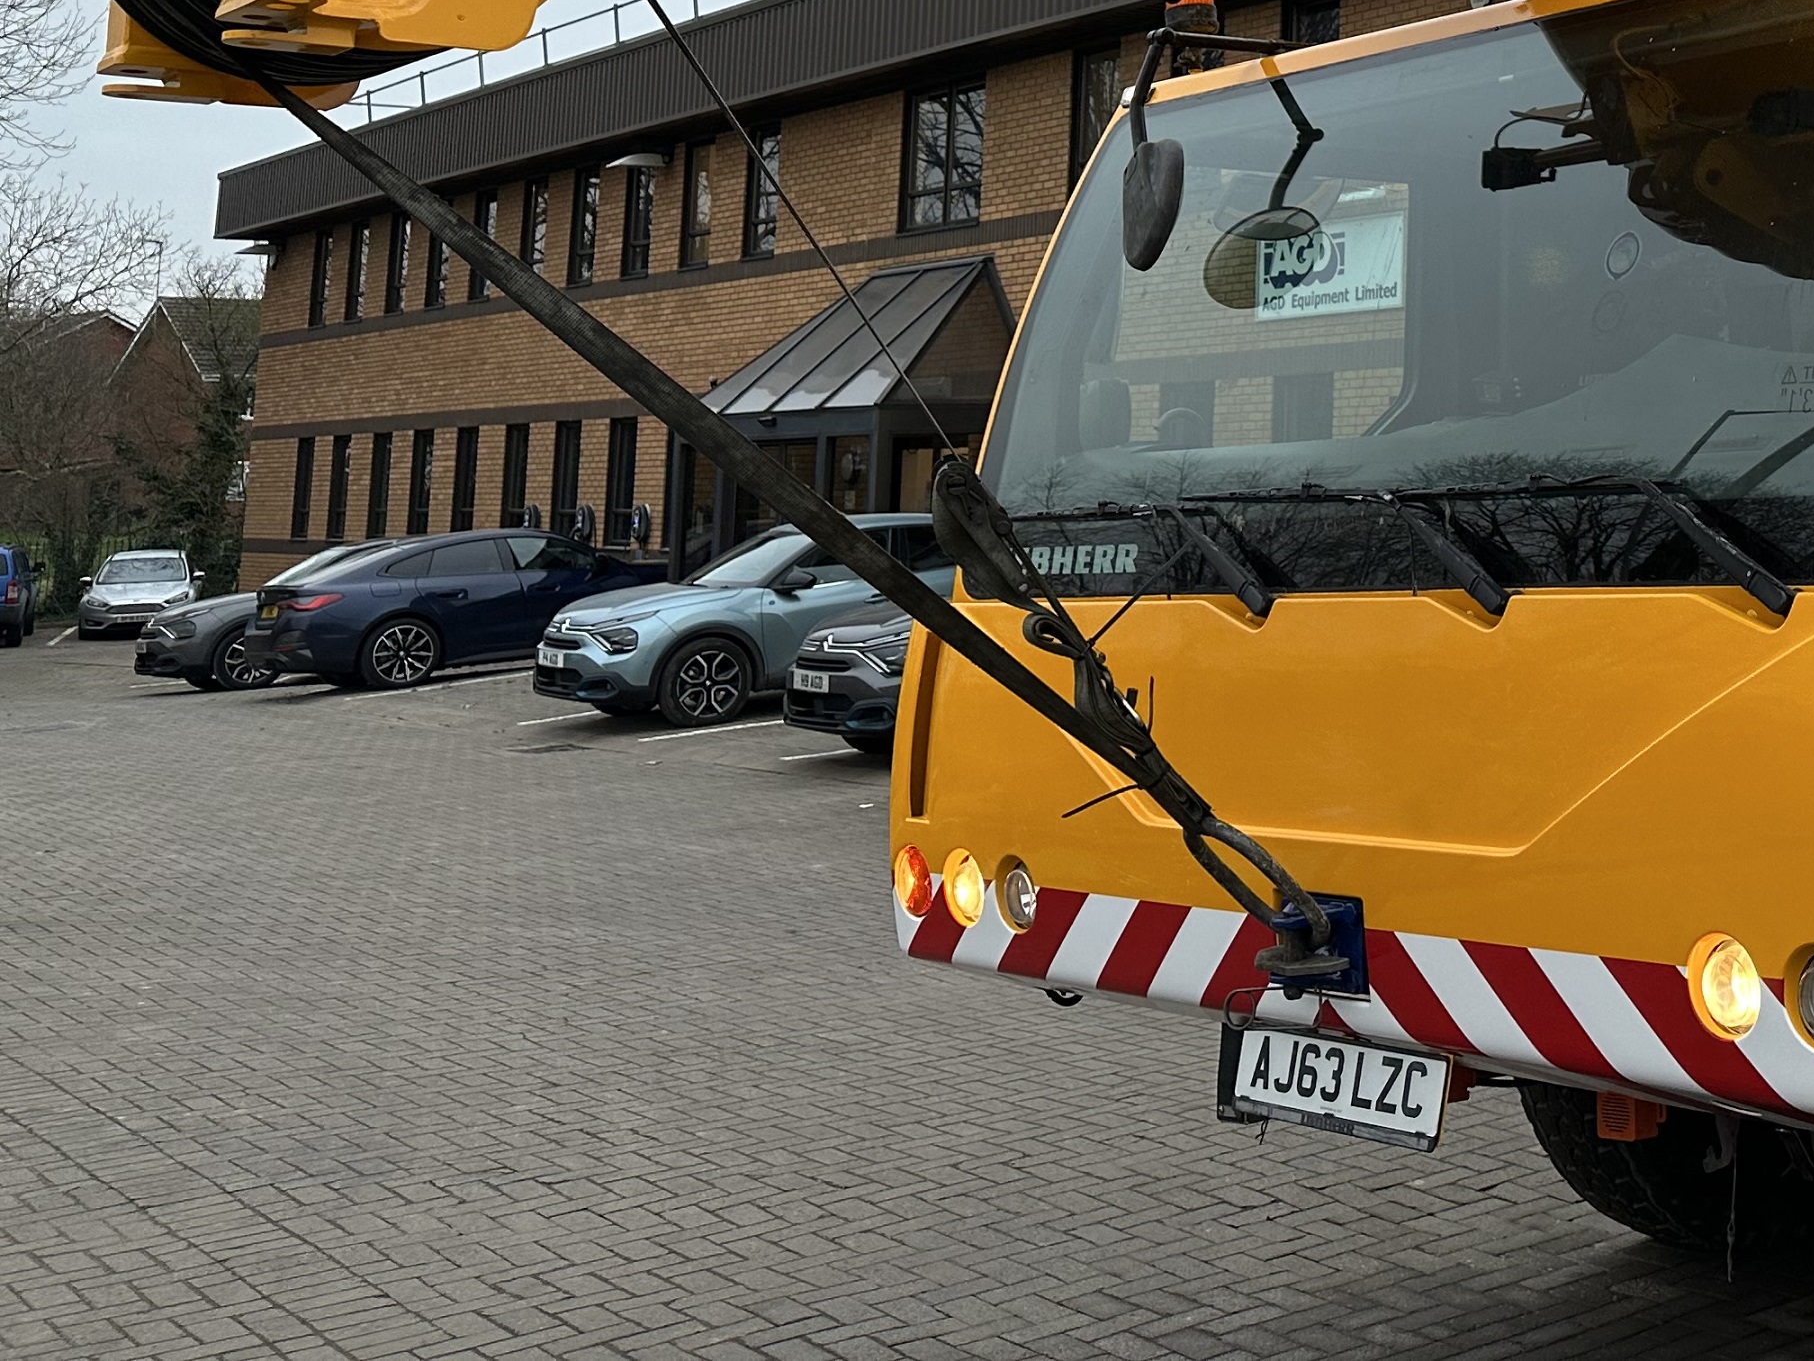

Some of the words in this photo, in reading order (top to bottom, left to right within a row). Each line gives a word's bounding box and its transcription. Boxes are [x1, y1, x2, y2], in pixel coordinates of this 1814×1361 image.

[1269, 231, 1333, 277] AGD
[1262, 295, 1286, 312] AGD
[1291, 288, 1350, 310] Equipment
[1355, 281, 1398, 301] Limited
[1023, 543, 1138, 575] BHERR
[1250, 1035, 1345, 1103] AJ63
[1350, 1051, 1428, 1119] LZC
